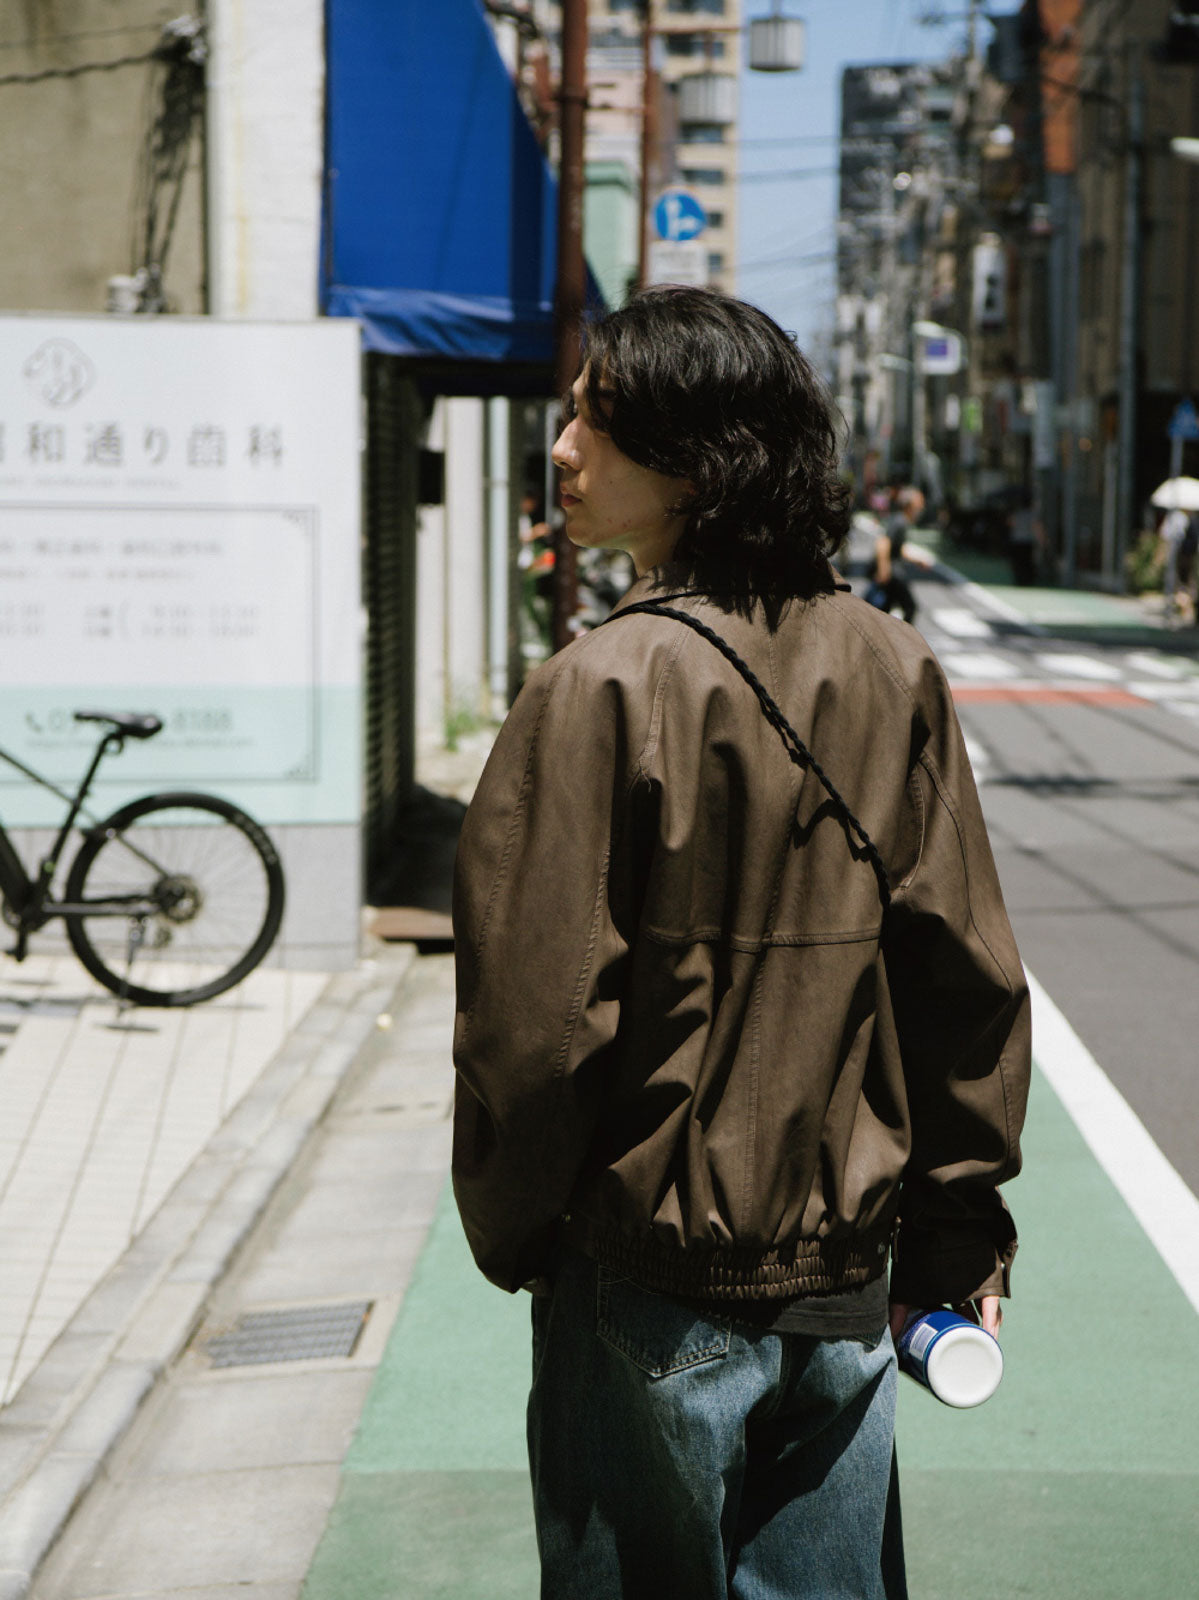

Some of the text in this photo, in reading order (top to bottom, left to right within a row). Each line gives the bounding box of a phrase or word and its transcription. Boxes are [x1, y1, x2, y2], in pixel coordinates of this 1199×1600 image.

[0, 420, 284, 468] 和通り歯科
